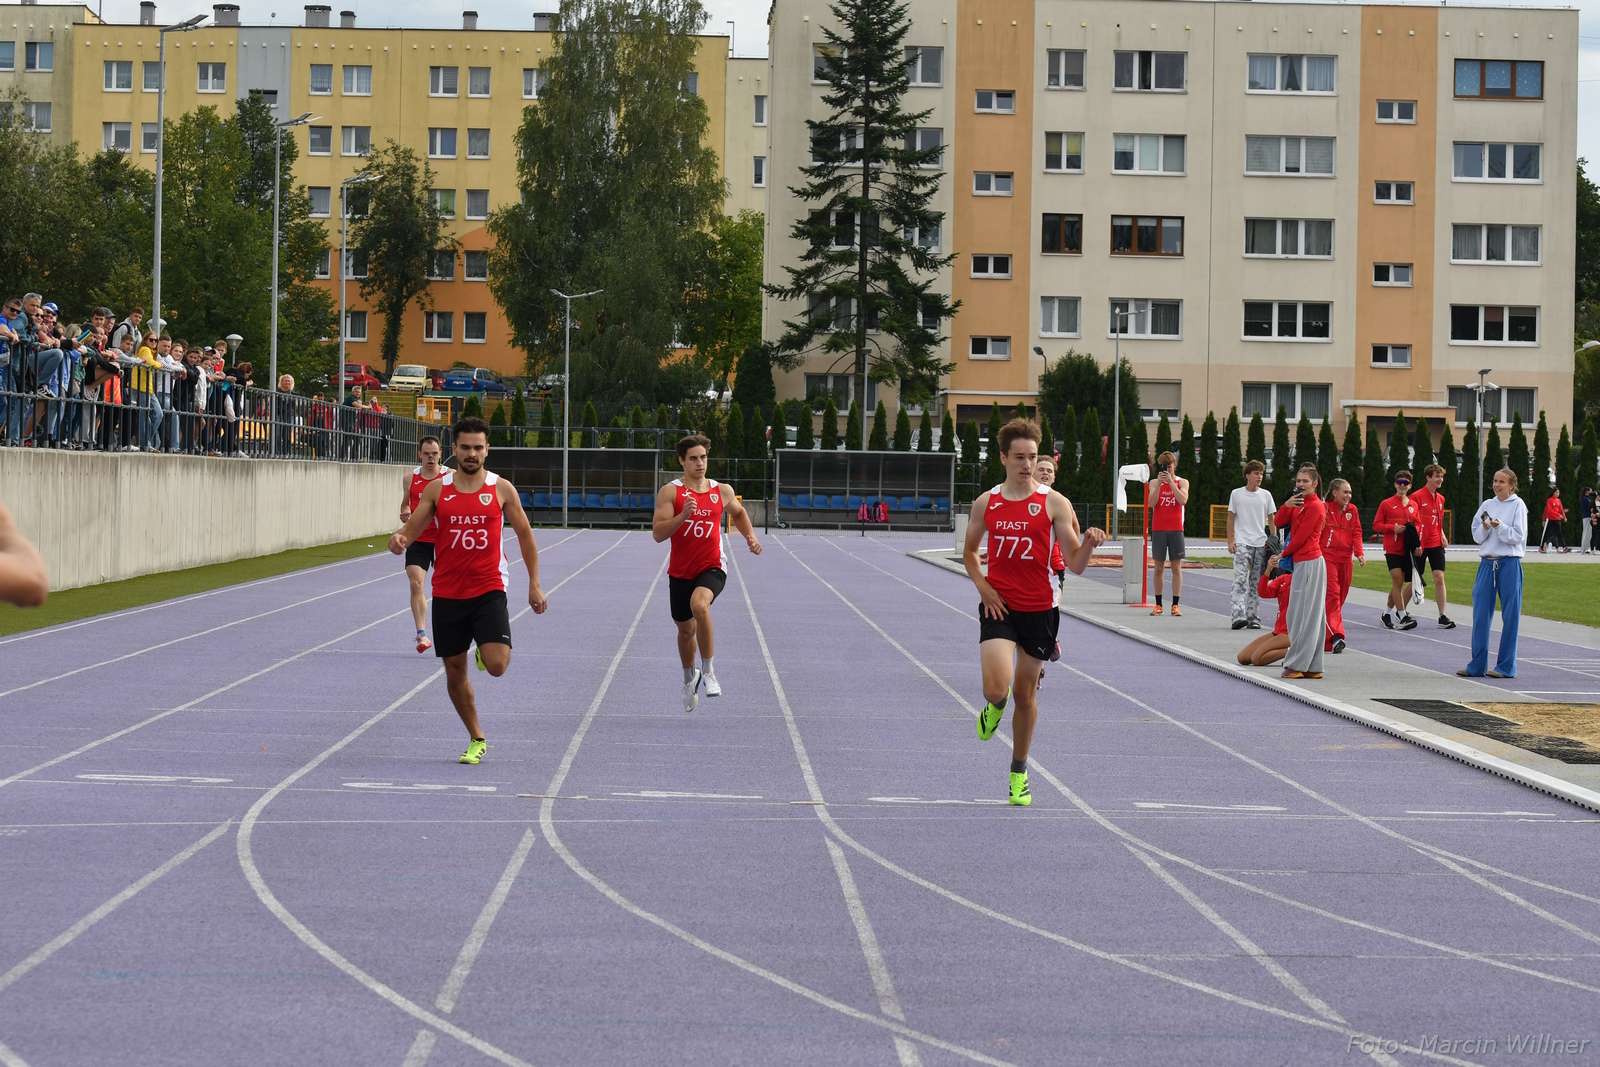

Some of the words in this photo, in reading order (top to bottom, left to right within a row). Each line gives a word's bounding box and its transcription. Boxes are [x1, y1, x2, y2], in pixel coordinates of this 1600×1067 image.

[1160, 496, 1176, 507] 754
[450, 515, 487, 524] PIAST
[995, 520, 1029, 531] PIAST
[683, 519, 714, 538] 767
[449, 529, 488, 550] 763
[994, 535, 1034, 560] 772
